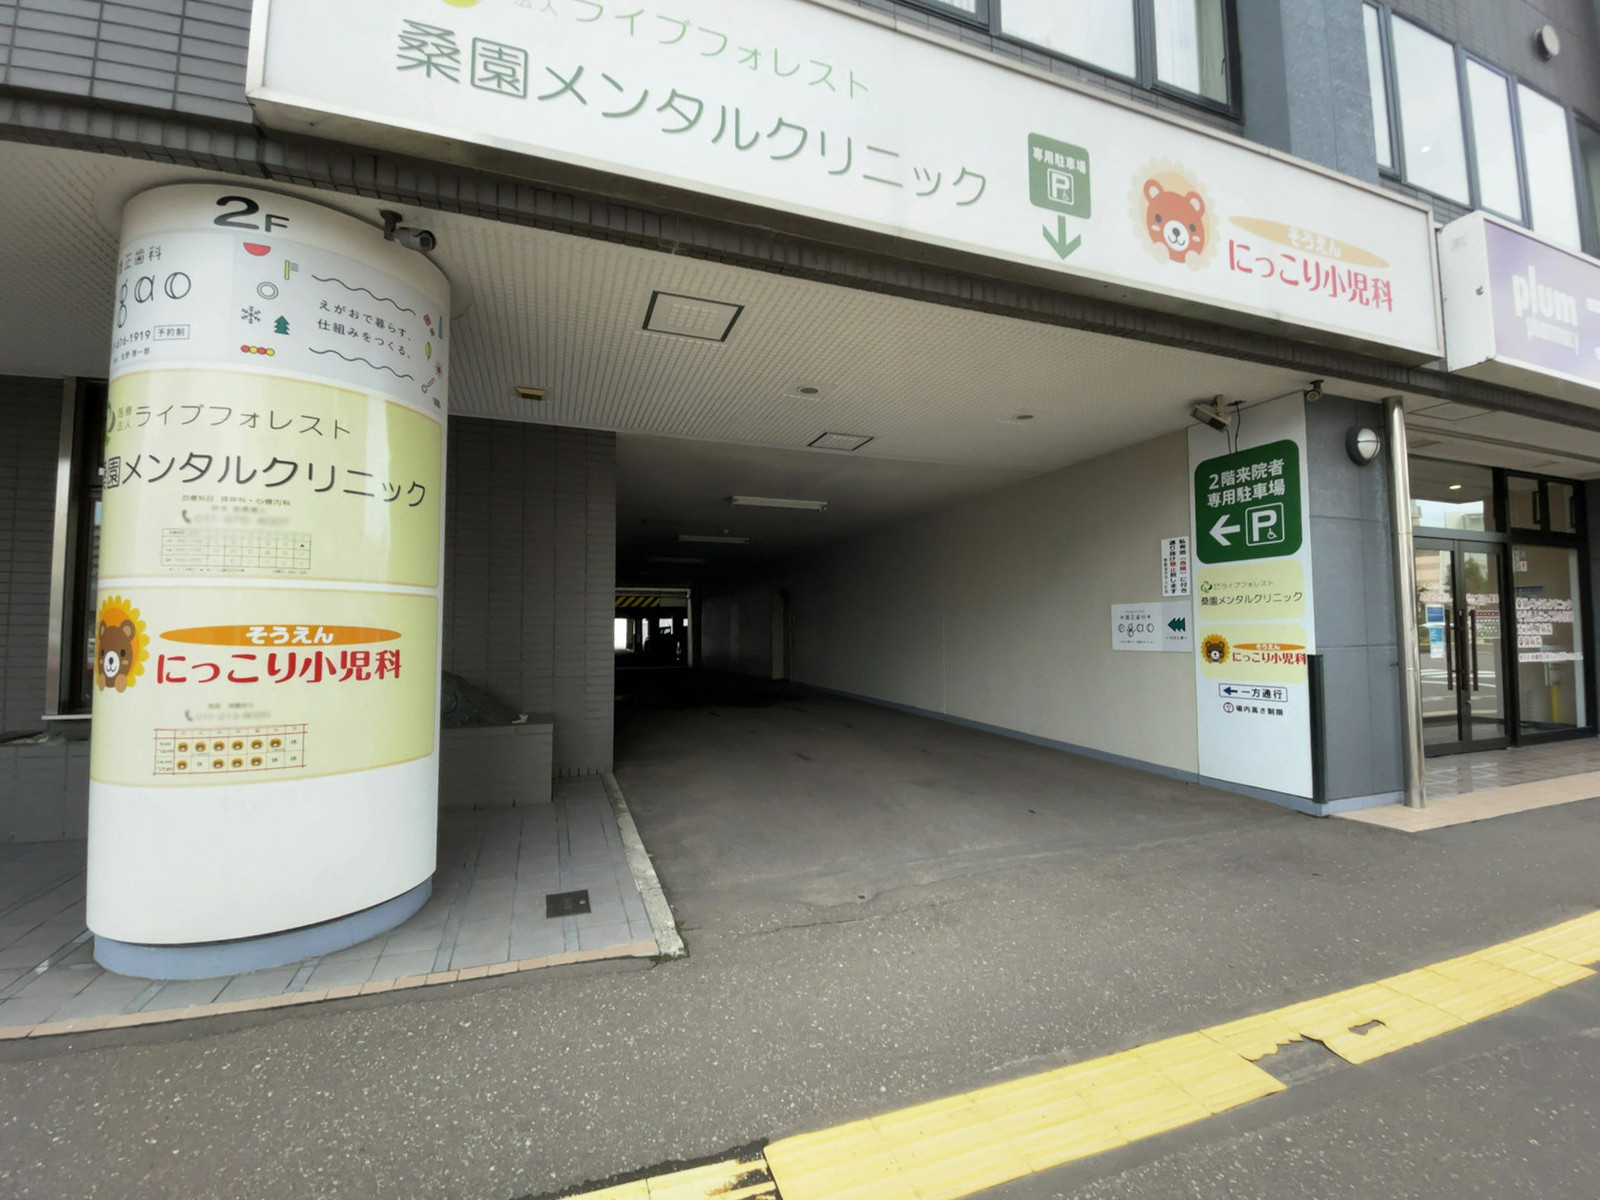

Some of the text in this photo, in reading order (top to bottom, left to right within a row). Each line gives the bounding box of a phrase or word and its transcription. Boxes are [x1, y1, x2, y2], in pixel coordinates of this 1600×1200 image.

[396, 18, 988, 206] 桑園メンタルクリニック
[1032, 146, 1086, 175] 専用駐車場
[213, 195, 290, 233] 2F
[1229, 239, 1393, 312] にっこり小児科
[1512, 265, 1578, 326] plum
[317, 318, 411, 360] 仕組みをつくる。
[135, 403, 350, 440] ライブフォレスト
[1209, 458, 1285, 490] 2階来院者
[1207, 478, 1286, 508] 専用駐車場
[1201, 592, 1303, 606] 桑園メンタルクリニック
[246, 626, 334, 645] そうえん
[1118, 623, 1155, 638] egao
[156, 649, 403, 684] にっこり小児科
[1232, 652, 1307, 665] にっこり小児科
[1241, 688, 1283, 700] 一方通行
